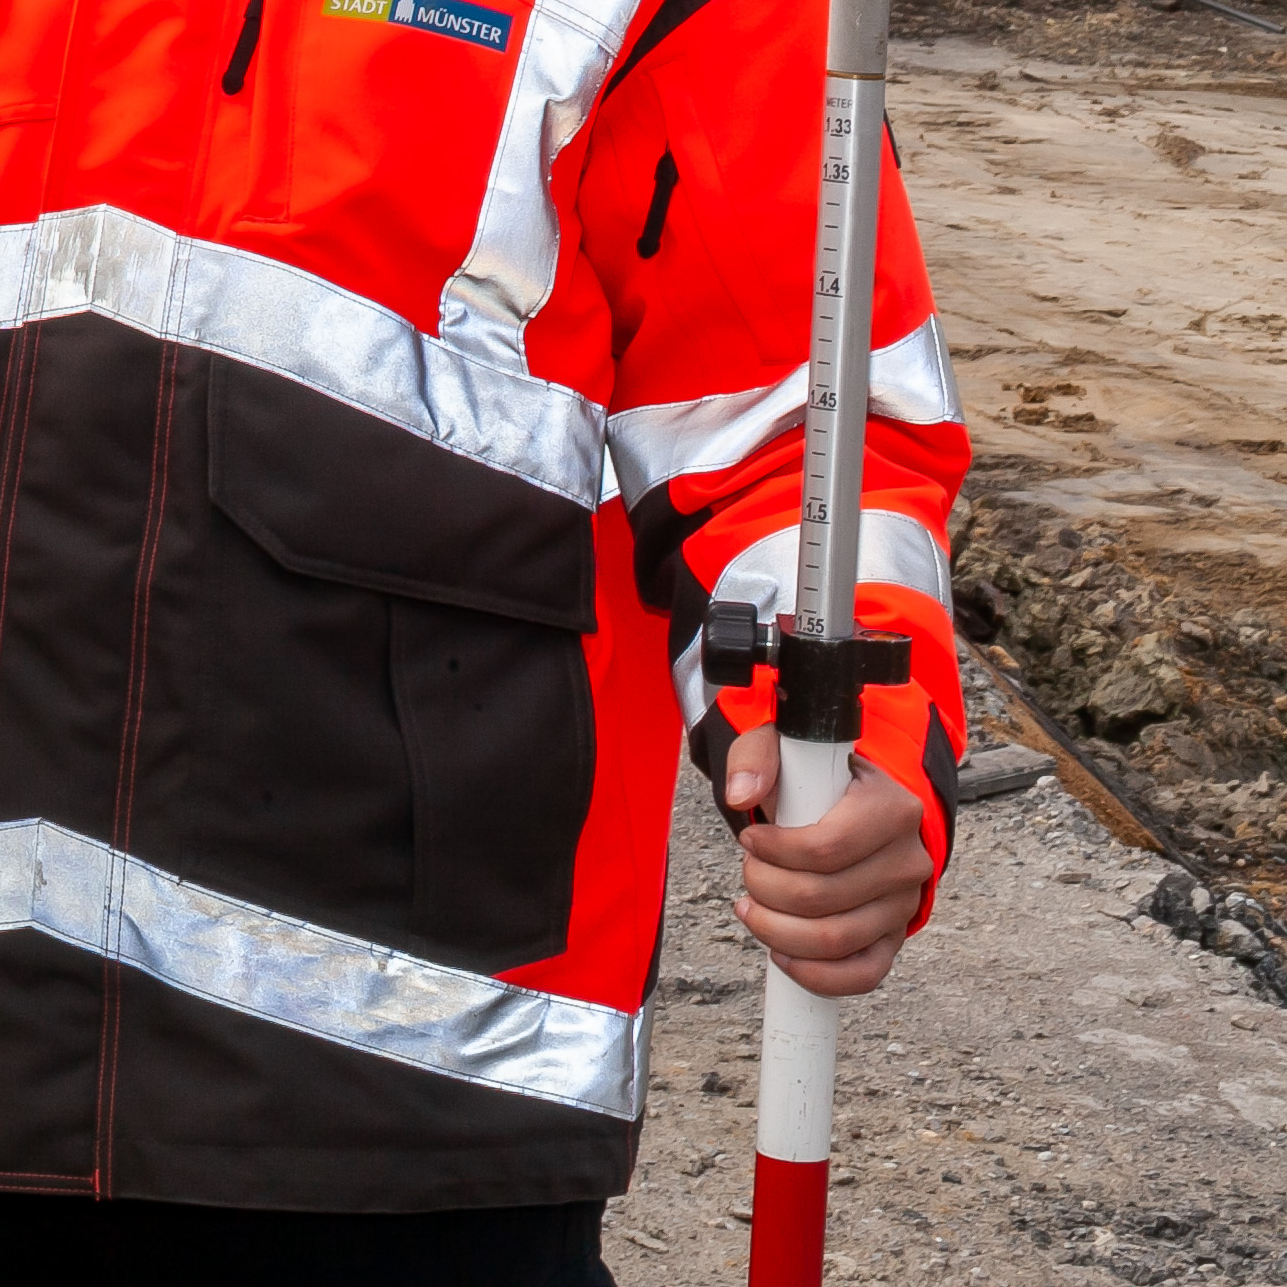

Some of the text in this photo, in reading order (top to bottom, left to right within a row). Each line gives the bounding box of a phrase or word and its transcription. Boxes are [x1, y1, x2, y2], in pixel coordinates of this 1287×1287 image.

[417, 7, 502, 44] MÜNSTER
[825, 117, 852, 134] 1.33
[822, 163, 850, 180] 1.35
[818, 275, 840, 294] 1.4
[810, 389, 837, 408] 1.45
[805, 501, 828, 521] 1.5
[797, 614, 825, 633] 1.55
